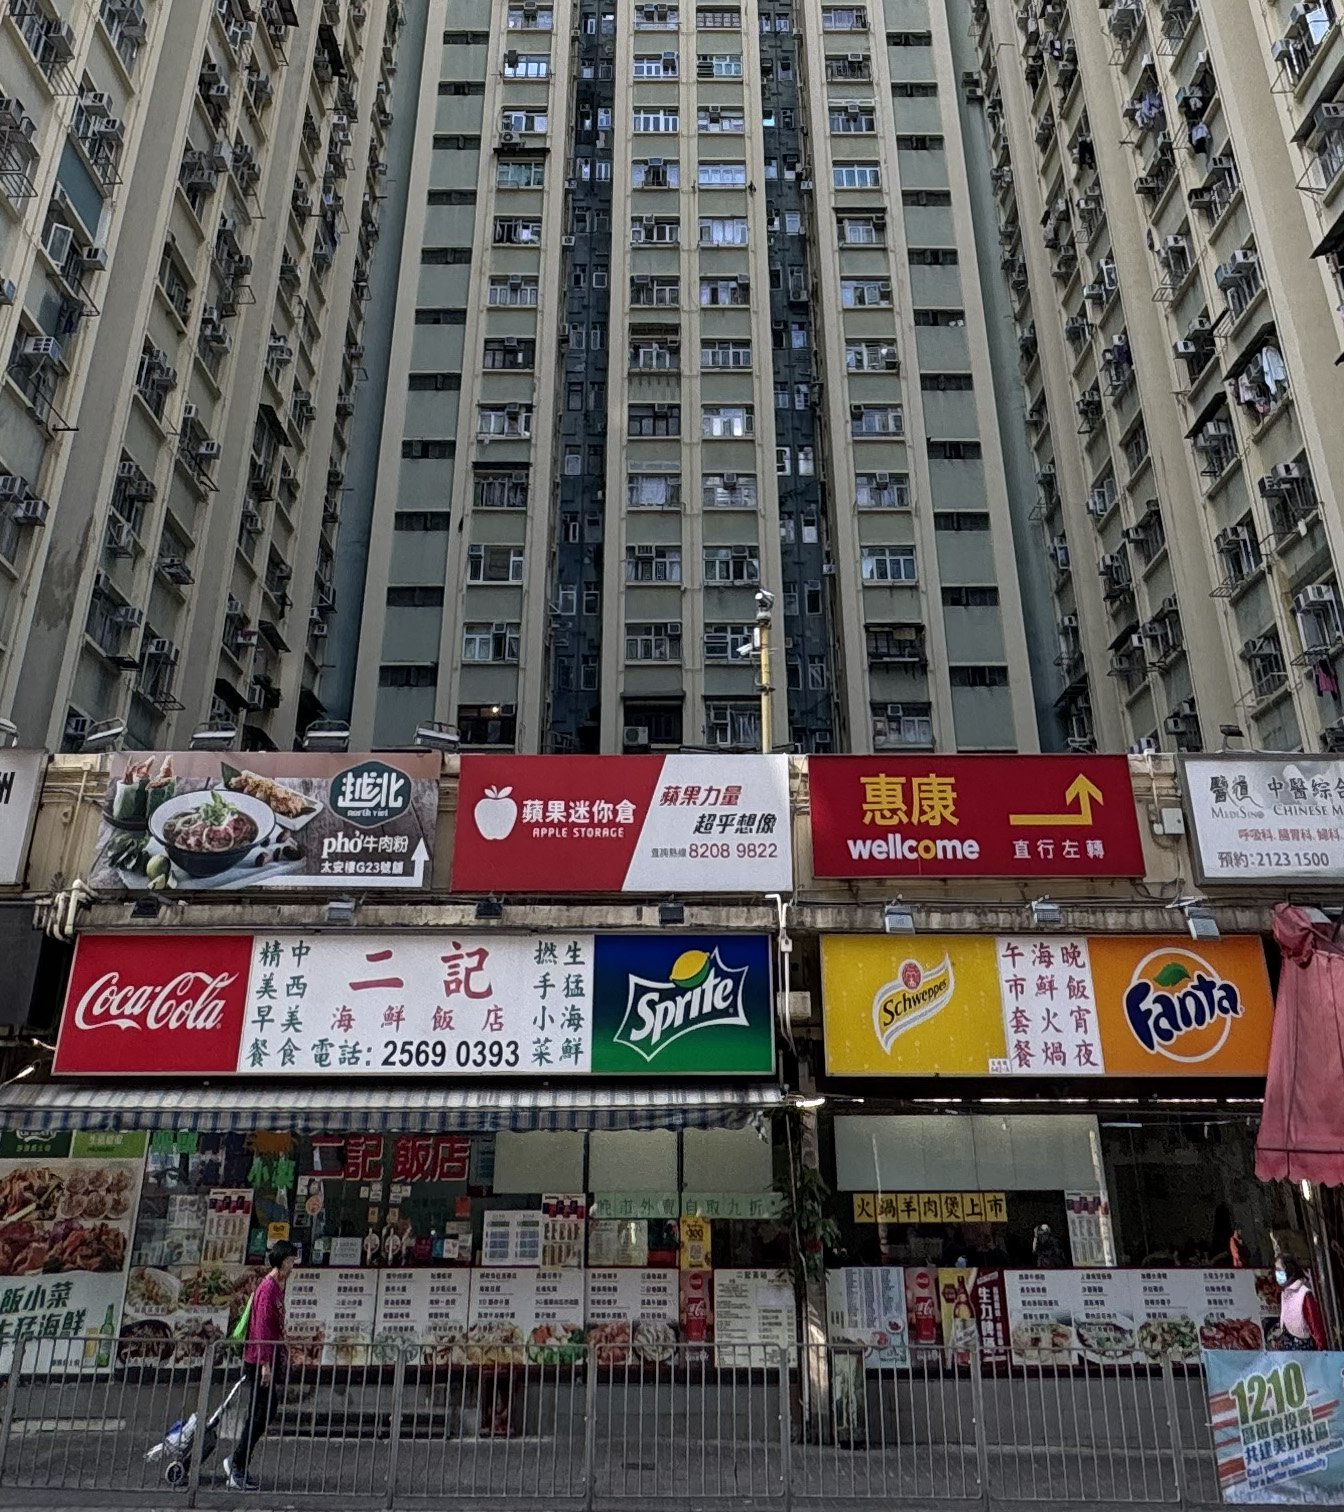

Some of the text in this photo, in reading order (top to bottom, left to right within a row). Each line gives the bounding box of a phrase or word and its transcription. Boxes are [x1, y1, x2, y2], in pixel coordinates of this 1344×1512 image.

[337, 772, 405, 807] 越北
[659, 785, 742, 806] 蘋果力量
[859, 773, 960, 826] 惠康
[522, 799, 637, 824] 蘋果迷你倉
[532, 827, 624, 838] APPLE STORAGE
[692, 813, 778, 835] 超乎想像
[363, 834, 409, 853] 牛肉粉
[689, 843, 730, 859] 8208
[736, 843, 778, 859] 9822
[847, 833, 980, 860] wellcome
[1012, 838, 1106, 860] 直行左轉
[1256, 852, 1291, 867] 2123
[1294, 852, 1329, 867] 1500
[348, 941, 494, 1000] 二記
[74, 971, 240, 1031] Coca-Cola
[246, 940, 285, 1068] 精美早餐
[276, 941, 311, 1065] 中西美食
[331, 1005, 505, 1033] 海鮮飯店
[559, 943, 587, 1066] 生猛海鮮
[629, 974, 734, 1046] Sprite
[882, 978, 948, 1027] Schweppes
[1001, 942, 1037, 1069] 午市套餐
[1060, 942, 1099, 1068] 晚飯宵夜
[1124, 973, 1241, 1053] Fanta
[310, 1038, 520, 1068] 電話: 2569 0393
[1230, 1362, 1306, 1425] 1210
